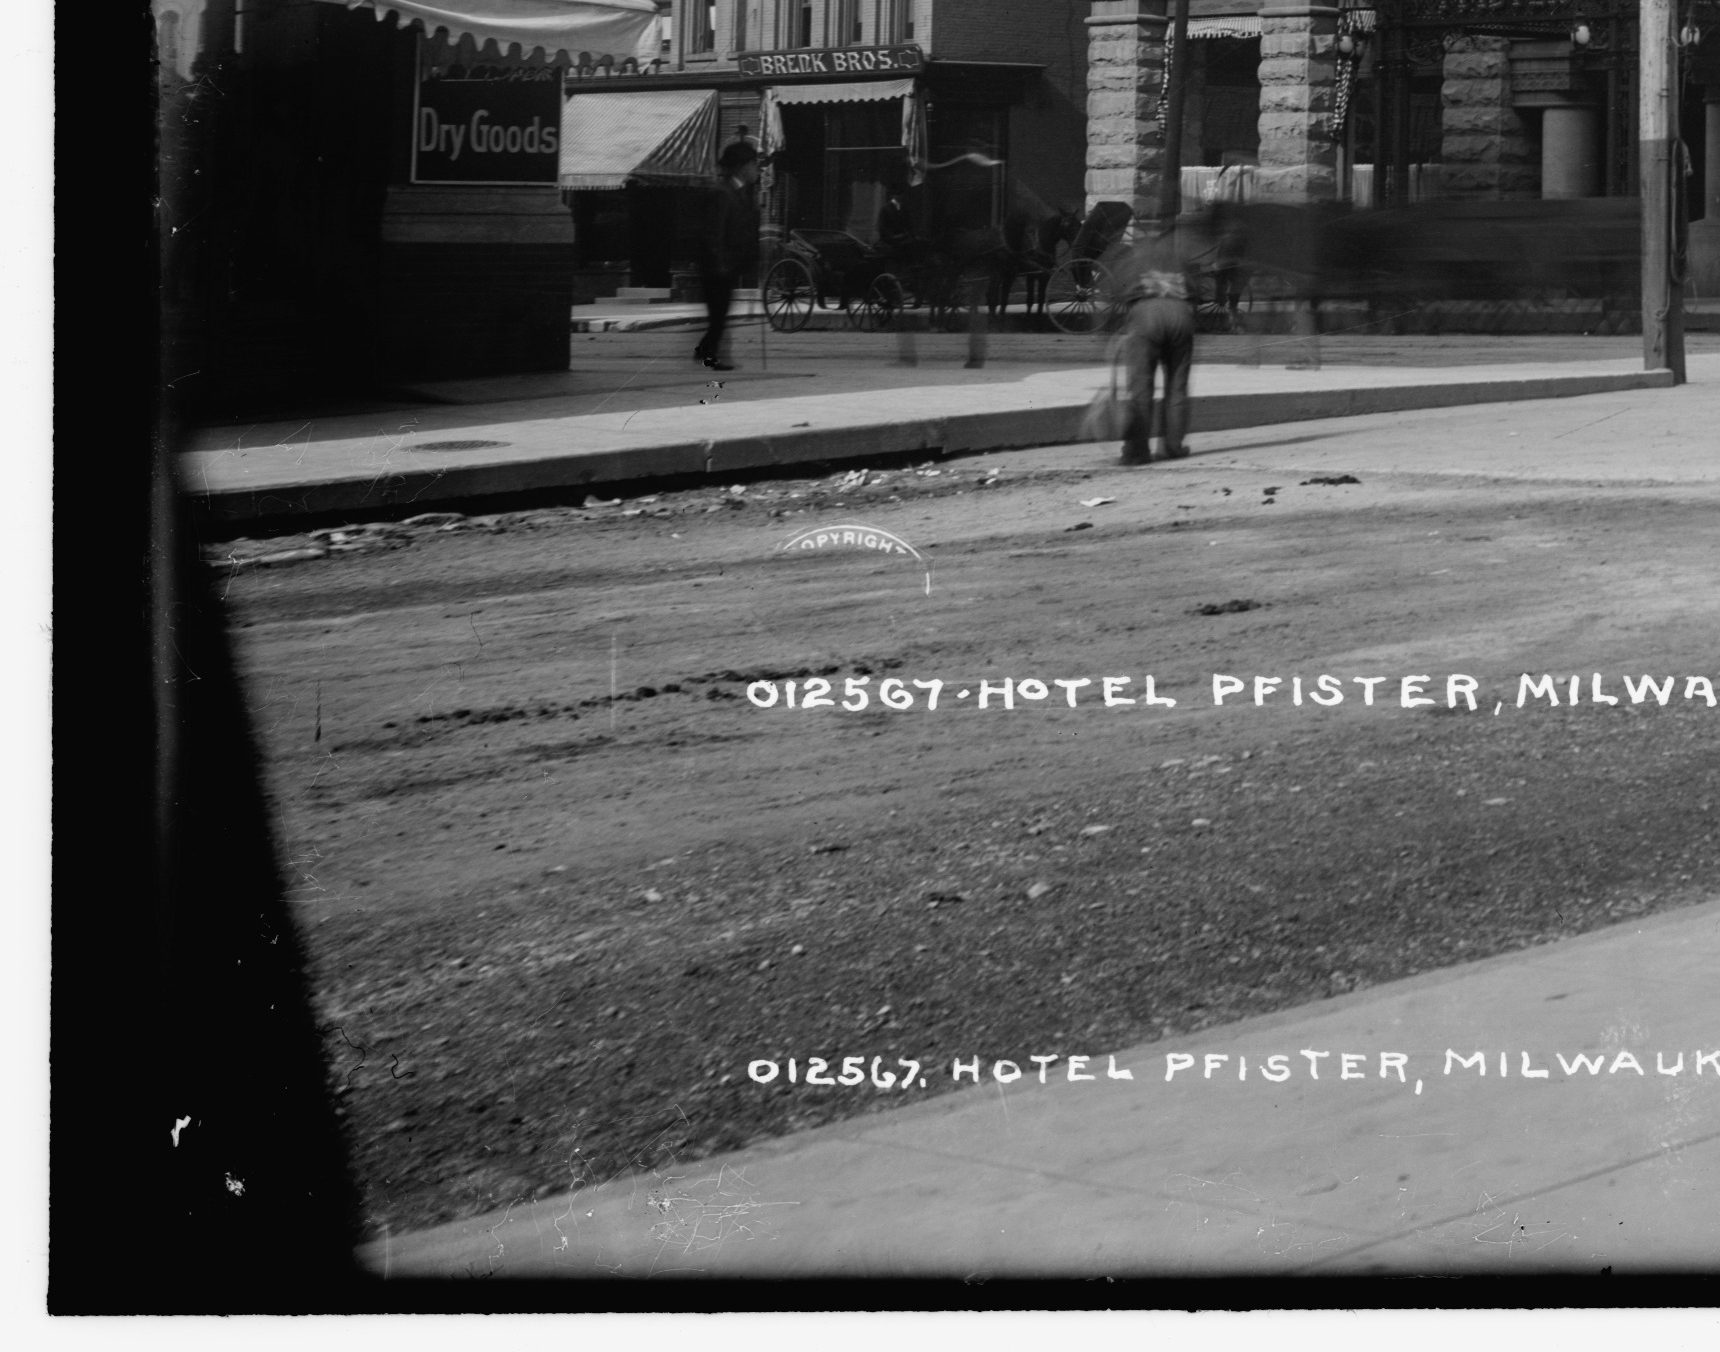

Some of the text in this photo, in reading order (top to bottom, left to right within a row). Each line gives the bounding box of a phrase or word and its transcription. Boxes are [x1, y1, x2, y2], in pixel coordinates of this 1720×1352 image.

[759, 49, 899, 75] BRENK BROS.
[418, 106, 560, 162] Dry Goods
